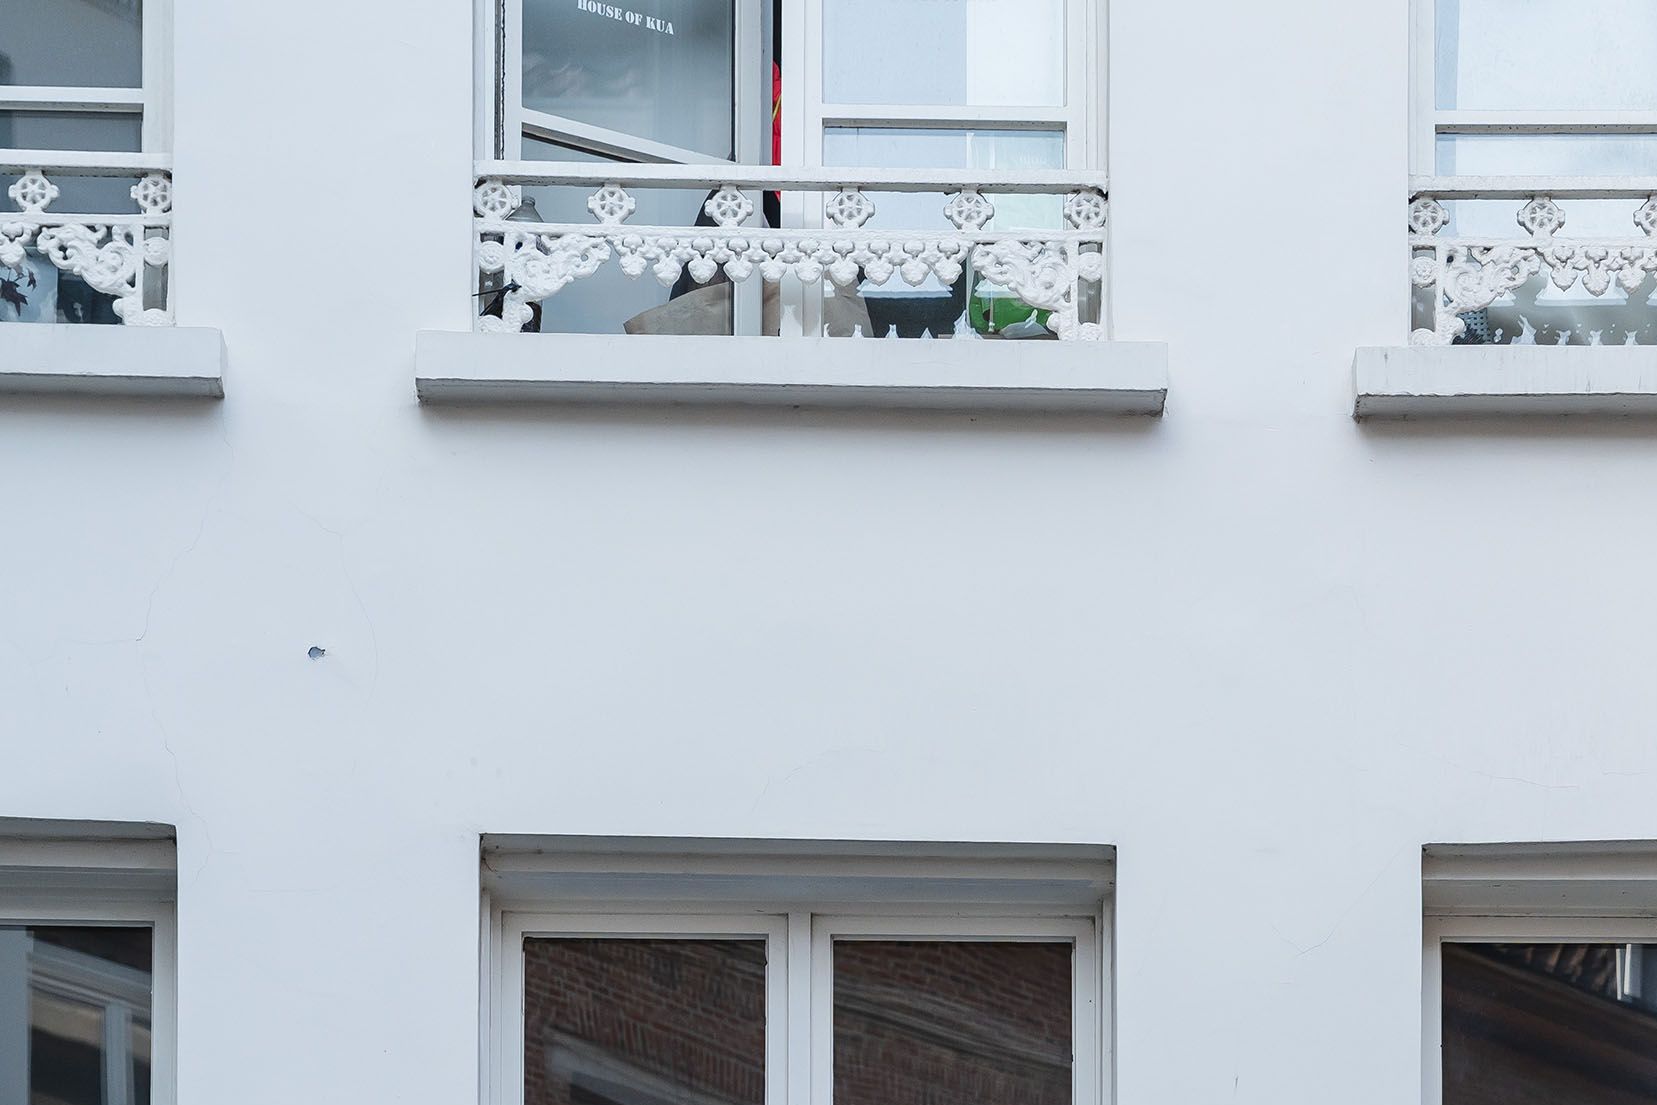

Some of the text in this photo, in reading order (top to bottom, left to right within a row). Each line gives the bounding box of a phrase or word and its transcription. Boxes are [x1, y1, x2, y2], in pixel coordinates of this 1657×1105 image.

[577, 0, 674, 35] HOUSE OF KUA
